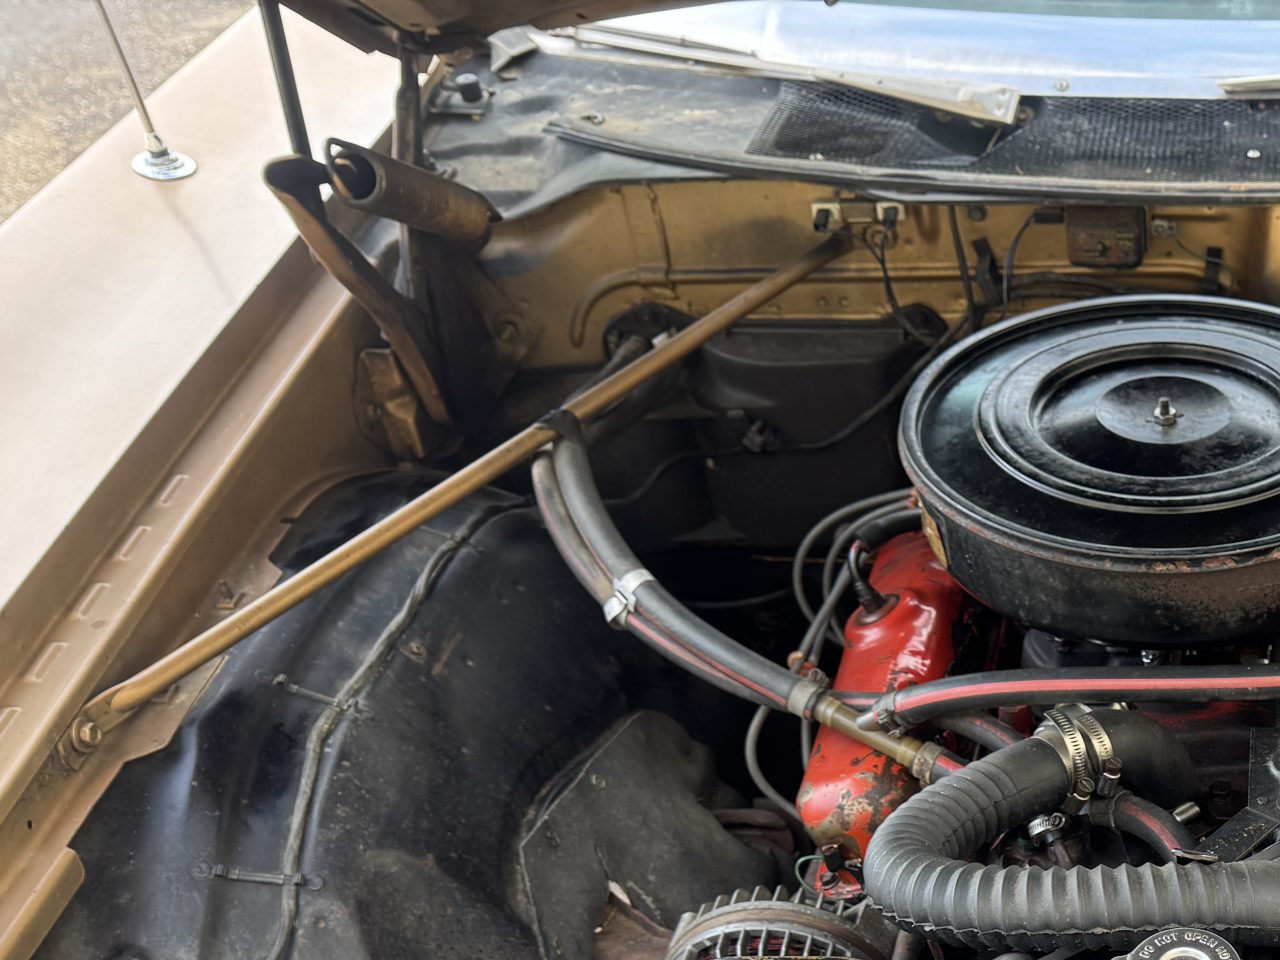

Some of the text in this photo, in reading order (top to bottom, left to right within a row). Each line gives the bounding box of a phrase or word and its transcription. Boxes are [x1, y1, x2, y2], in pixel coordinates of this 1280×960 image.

[1139, 944, 1155, 959] DO
[1154, 932, 1178, 947] NOT
[1184, 931, 1219, 948] OPEN
